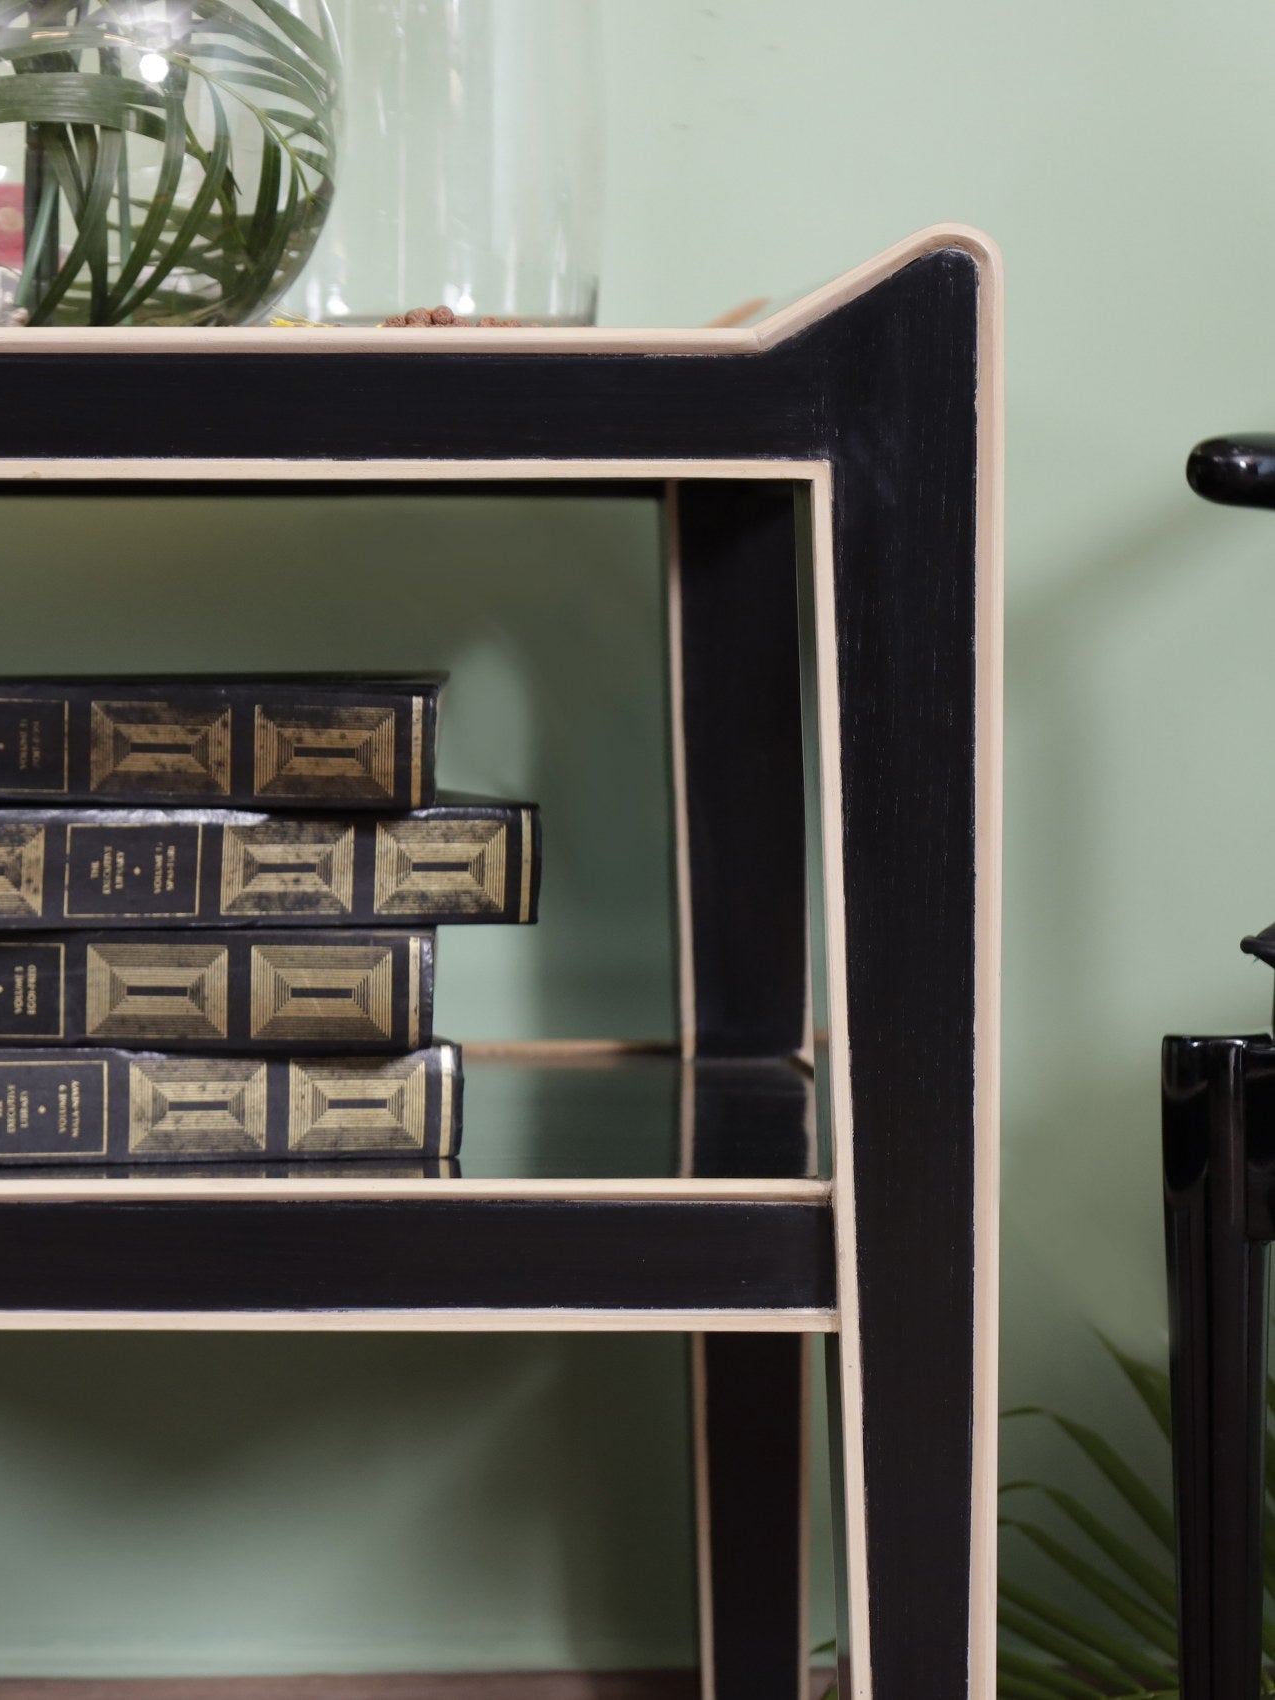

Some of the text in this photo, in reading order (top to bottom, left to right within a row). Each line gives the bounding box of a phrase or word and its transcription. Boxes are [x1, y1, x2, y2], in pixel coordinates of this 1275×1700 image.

[90, 860, 100, 879] THE
[102, 845, 113, 895] EXECUTIVE
[115, 851, 125, 890] LIBRARY
[153, 854, 163, 894] VOLUME
[14, 974, 24, 1015] VOLUME
[6, 1084, 17, 1134] EXECUTIVE
[19, 1090, 29, 1129] LIBRARY
[58, 1093, 68, 1134] VOLUME
